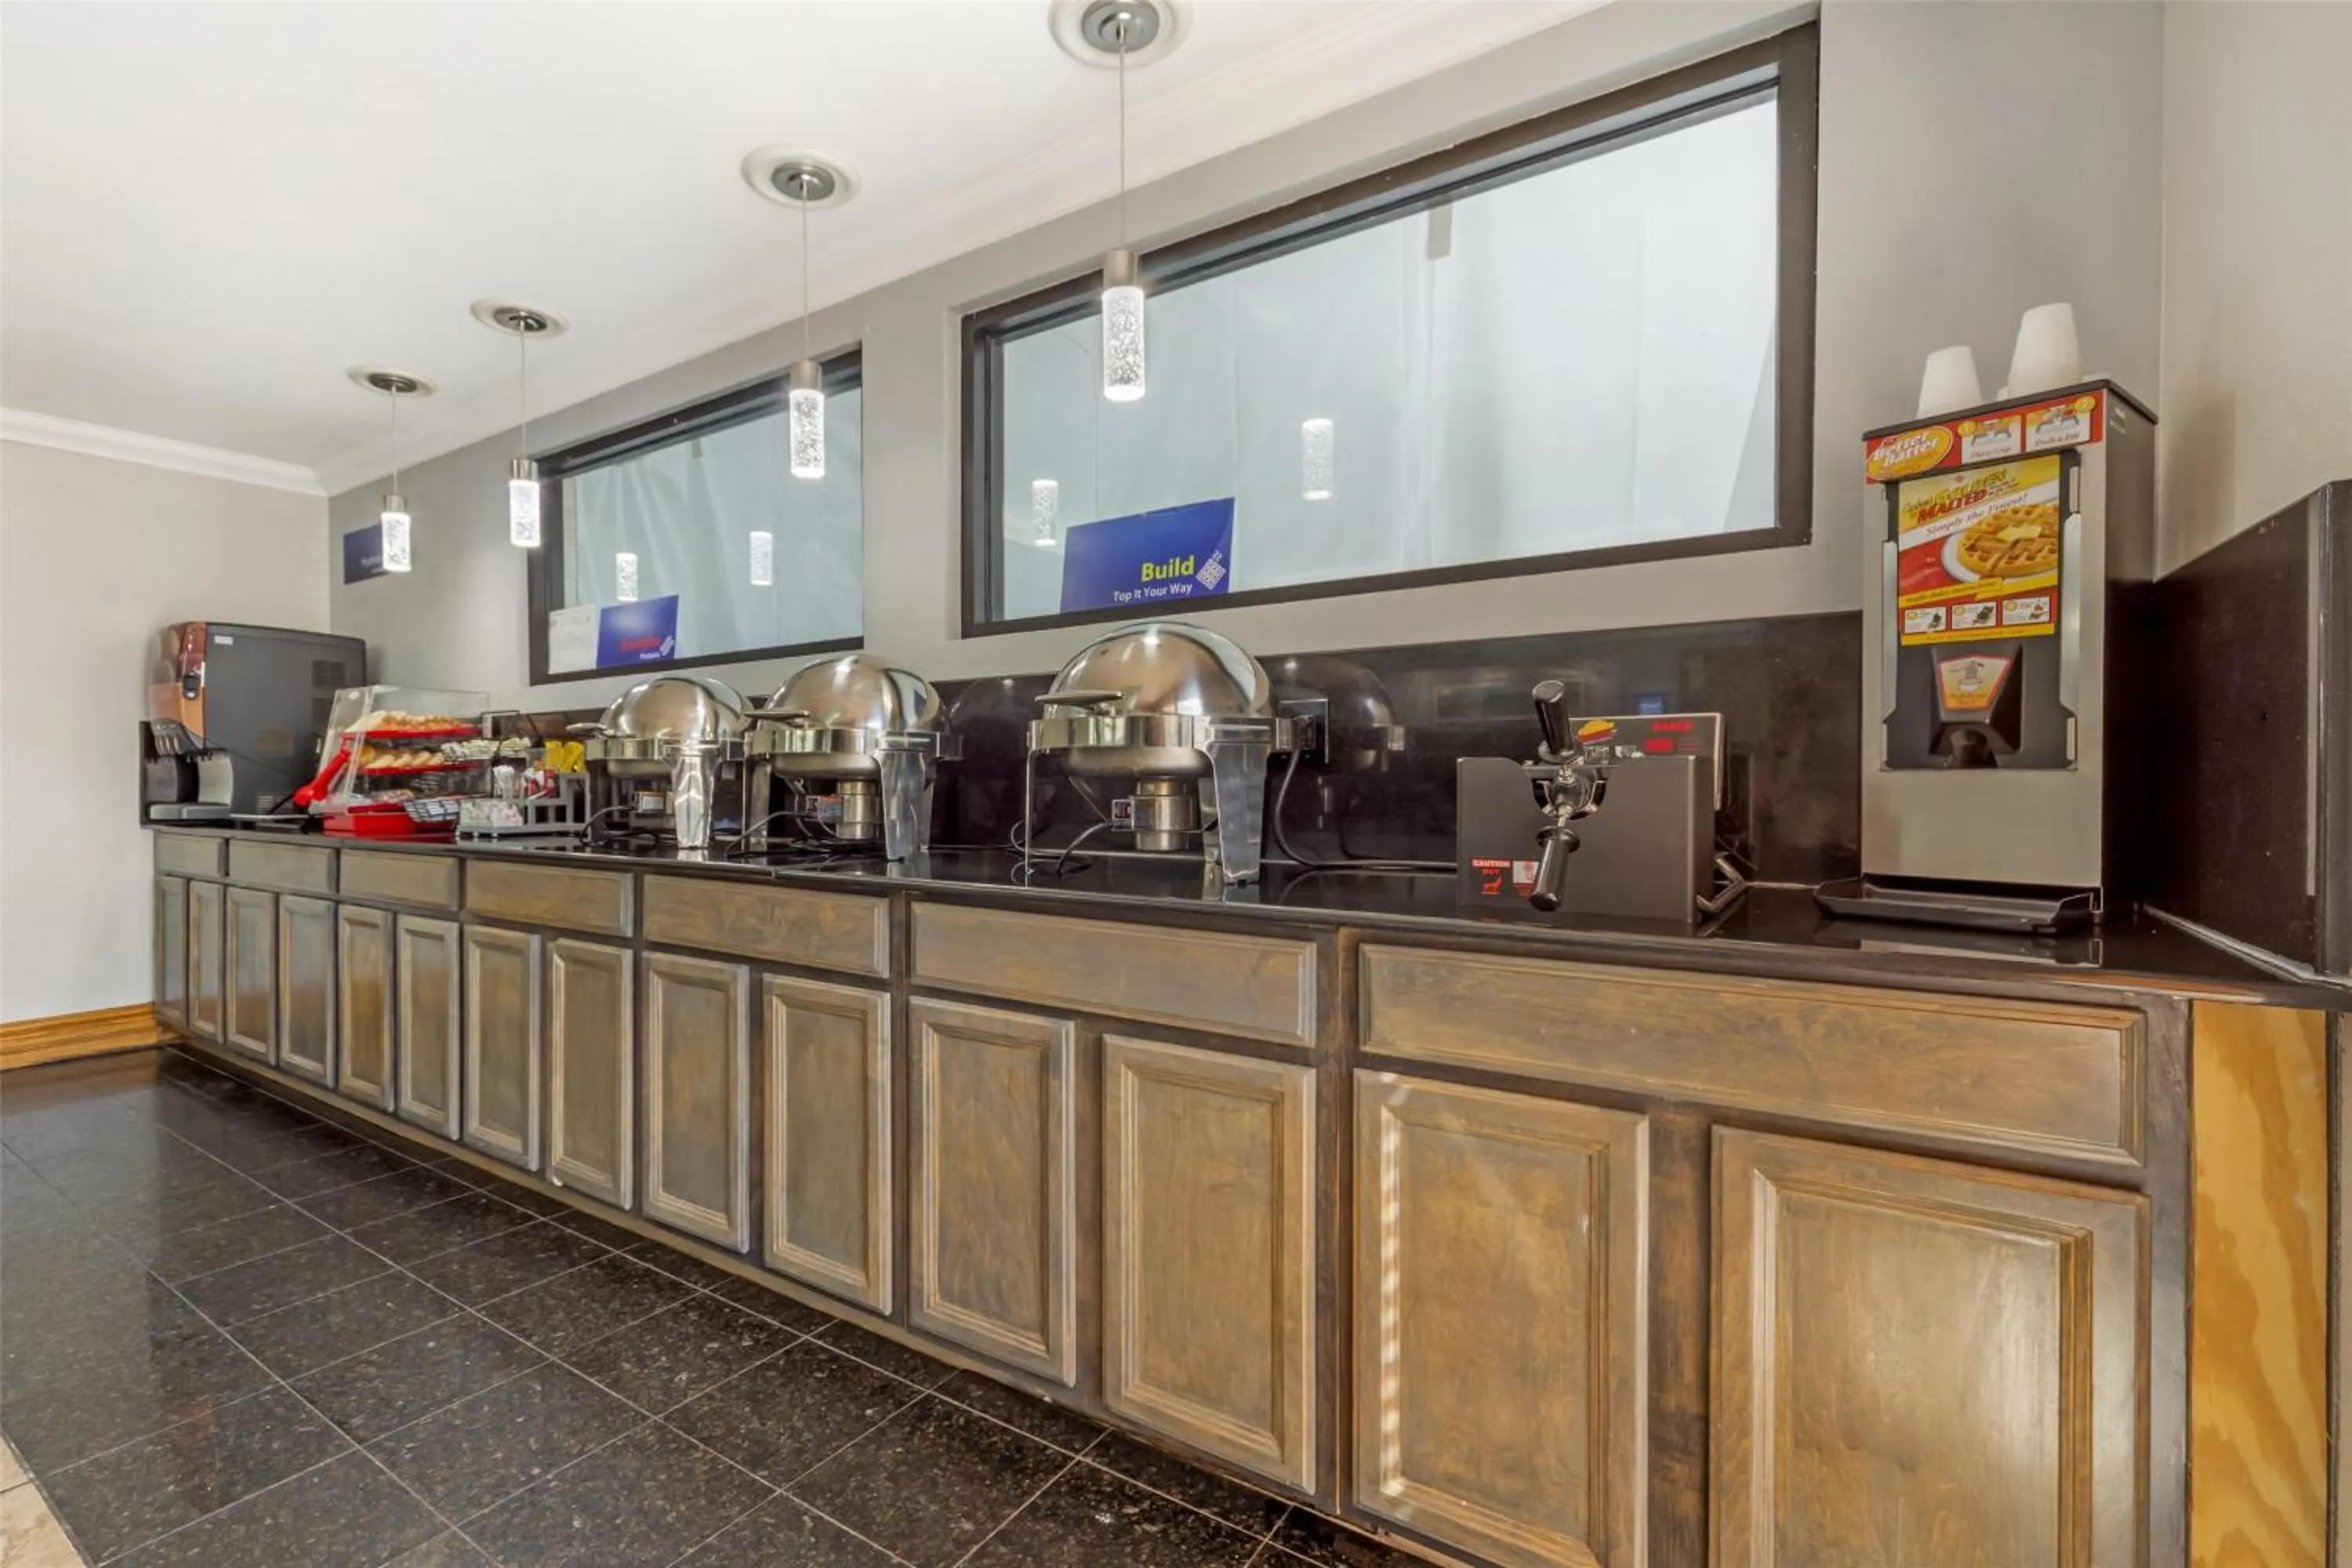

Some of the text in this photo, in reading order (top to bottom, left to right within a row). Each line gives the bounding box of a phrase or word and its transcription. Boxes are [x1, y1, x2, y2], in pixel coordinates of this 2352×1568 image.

[1917, 488, 1988, 523] MALTED
[1926, 516, 1963, 535] Simply
[1967, 509, 1985, 521] the
[1142, 554, 1195, 582] Build
[1113, 583, 1192, 603] Top It Your Way
